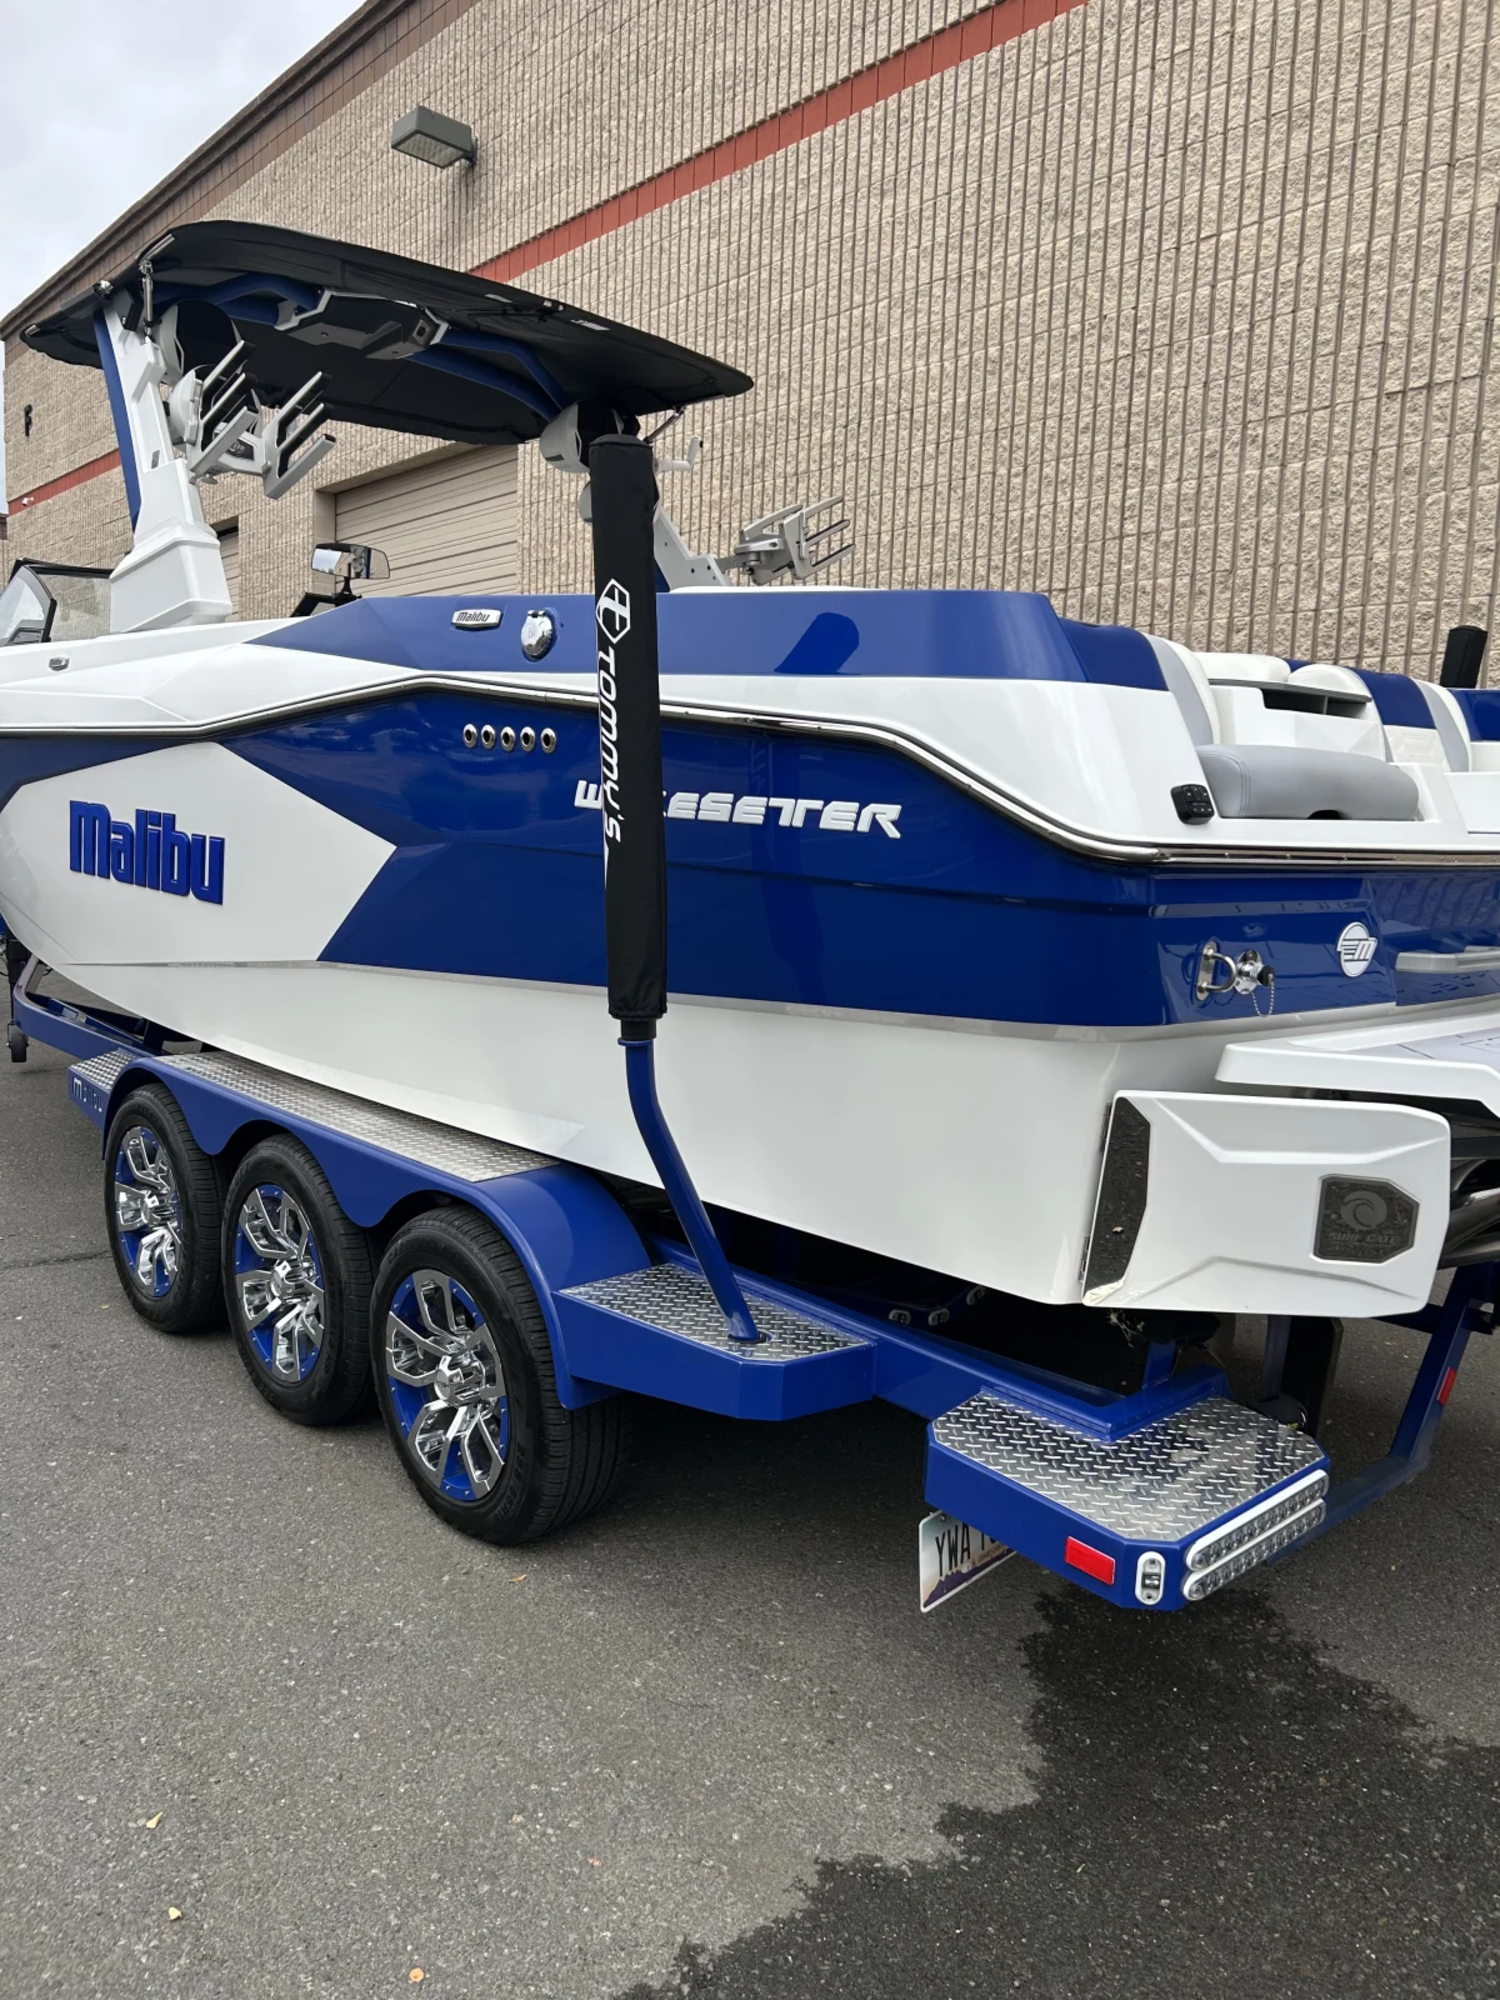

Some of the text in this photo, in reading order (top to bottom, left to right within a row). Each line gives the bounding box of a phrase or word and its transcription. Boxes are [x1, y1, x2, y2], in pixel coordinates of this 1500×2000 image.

[456, 611, 491, 622] Malibu
[574, 779, 902, 839] WESETTER
[69, 800, 226, 905] Malibu
[935, 1522, 970, 1577] YWA
